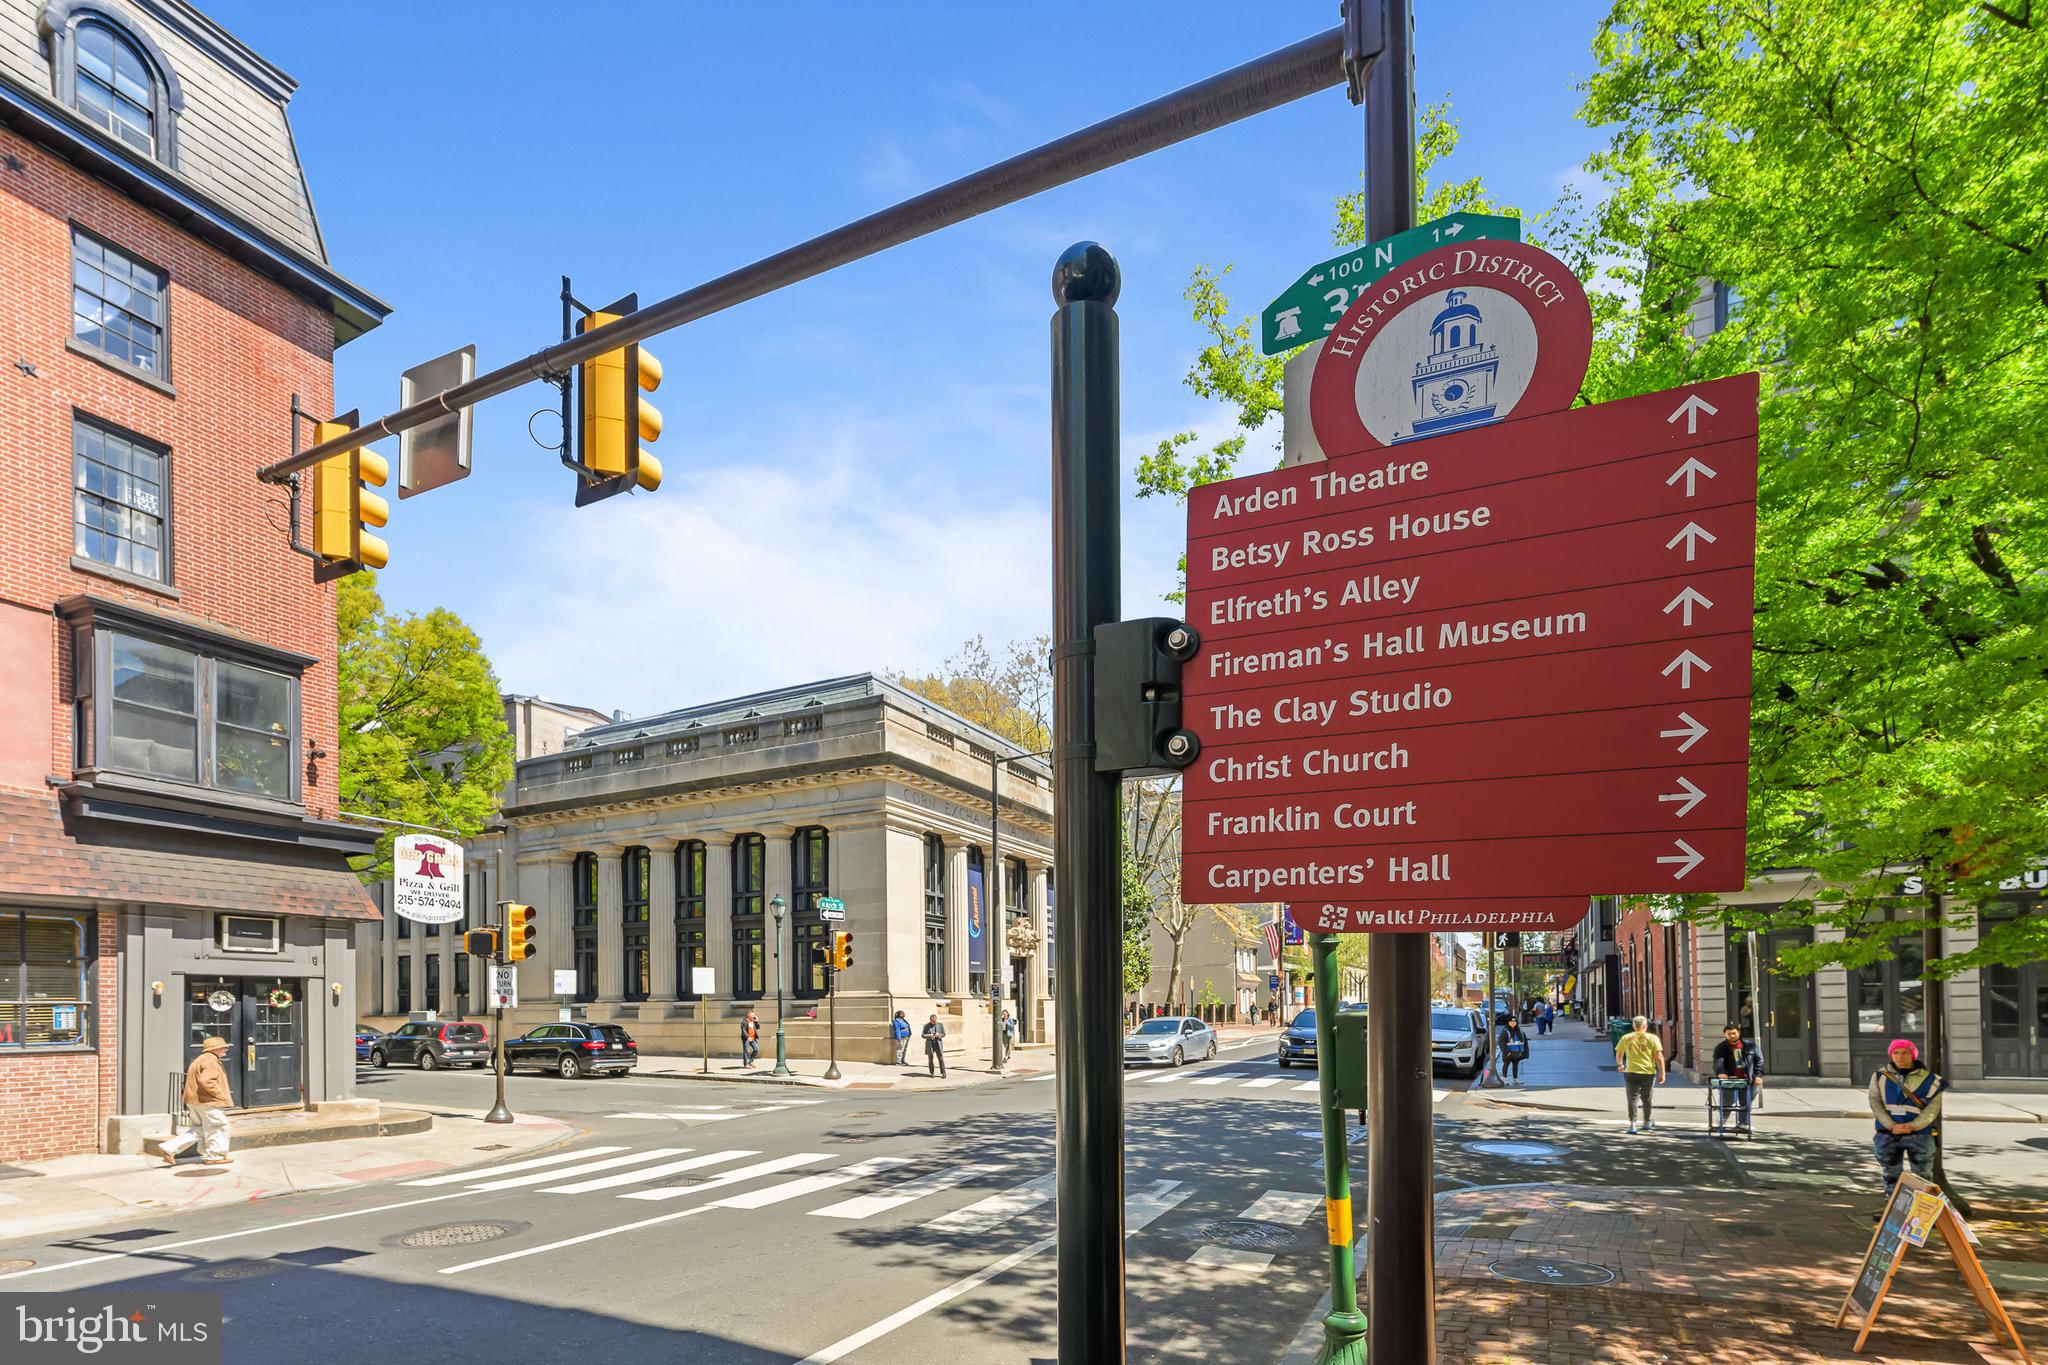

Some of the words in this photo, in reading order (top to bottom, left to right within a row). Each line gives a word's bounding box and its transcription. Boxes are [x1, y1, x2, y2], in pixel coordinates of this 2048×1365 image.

[1329, 257, 1364, 281] 100
[1375, 242, 1393, 269] N
[1329, 262, 1446, 358] HISTORIC
[1451, 249, 1565, 309] DISTRICT
[1213, 487, 1298, 520] Arden
[1310, 461, 1429, 500] Theatre
[1211, 541, 1290, 572] Betsy
[1303, 526, 1374, 556] Ross
[1389, 506, 1491, 540] House
[1211, 586, 1328, 626] Elfreth's
[1339, 574, 1421, 606] Alley
[1210, 638, 1350, 678] Fireman's
[1363, 625, 1425, 659] Hall
[1438, 612, 1586, 651] Museum
[1210, 703, 1261, 730] The
[1273, 696, 1337, 727] Clay
[1348, 682, 1452, 716] Studio
[1209, 754, 1291, 783] Christ
[1302, 742, 1409, 776] Church
[944, 801, 995, 827] EXCHANG
[1208, 805, 1320, 837] Franklin
[1333, 800, 1417, 829] Court
[399, 877, 424, 889] Pizza
[428, 882, 435, 890] &
[439, 882, 460, 893] Grill
[1208, 857, 1374, 893] Carpenters'
[1389, 853, 1451, 883] Hall
[397, 894, 461, 909] 215-574-9494
[424, 890, 450, 899] DELIVER
[1355, 909, 1413, 926] Walk!
[1417, 909, 1556, 925] PHILADELPHIA
[496, 980, 512, 988] TURN
[497, 971, 510, 979] NO
[503, 988, 514, 996] RED
